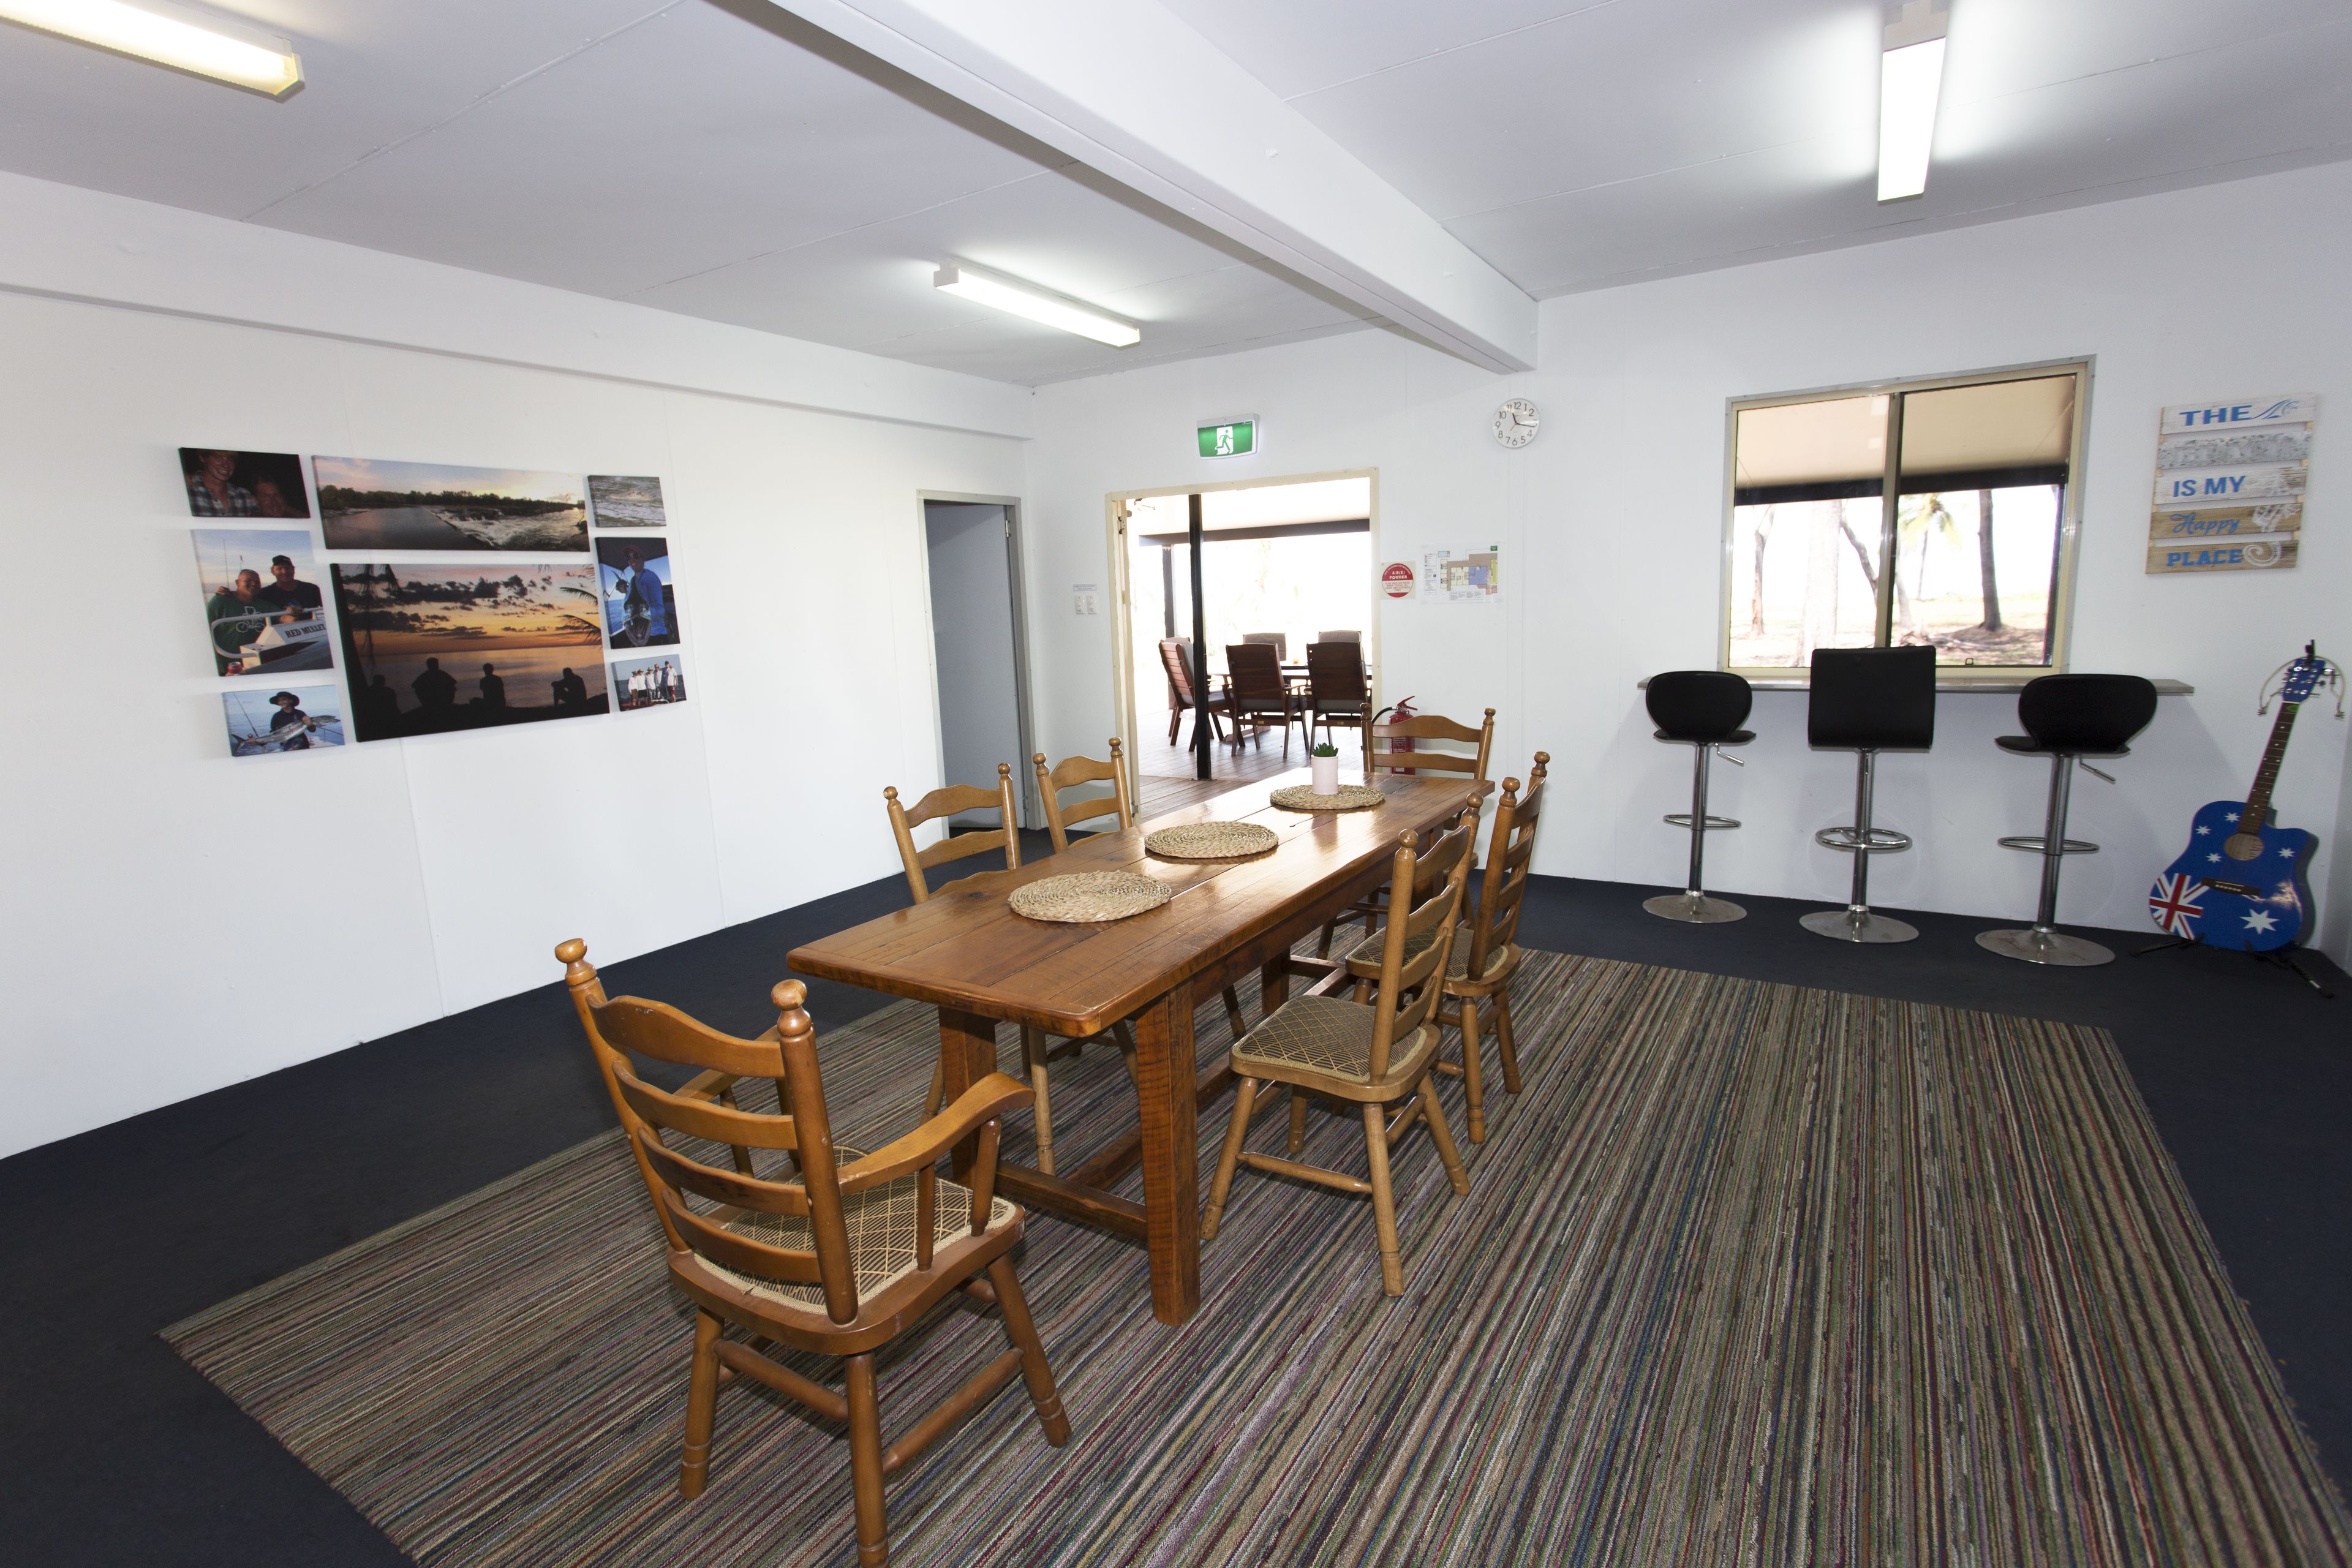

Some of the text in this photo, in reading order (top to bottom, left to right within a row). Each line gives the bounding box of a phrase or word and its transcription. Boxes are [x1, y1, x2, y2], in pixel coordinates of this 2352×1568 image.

[1513, 401, 1522, 410] 12
[1528, 408, 1534, 417] 2
[2179, 405, 2253, 426] THE
[1495, 421, 1501, 429] 9
[1498, 430, 1504, 439] 8
[1512, 437, 1518, 446] 6
[1520, 435, 1526, 444] 5
[2173, 475, 2247, 497] IS MY
[2169, 513, 2241, 535] Happy
[2166, 548, 2245, 567] PLACE
[284, 624, 326, 638] RED MULLET
